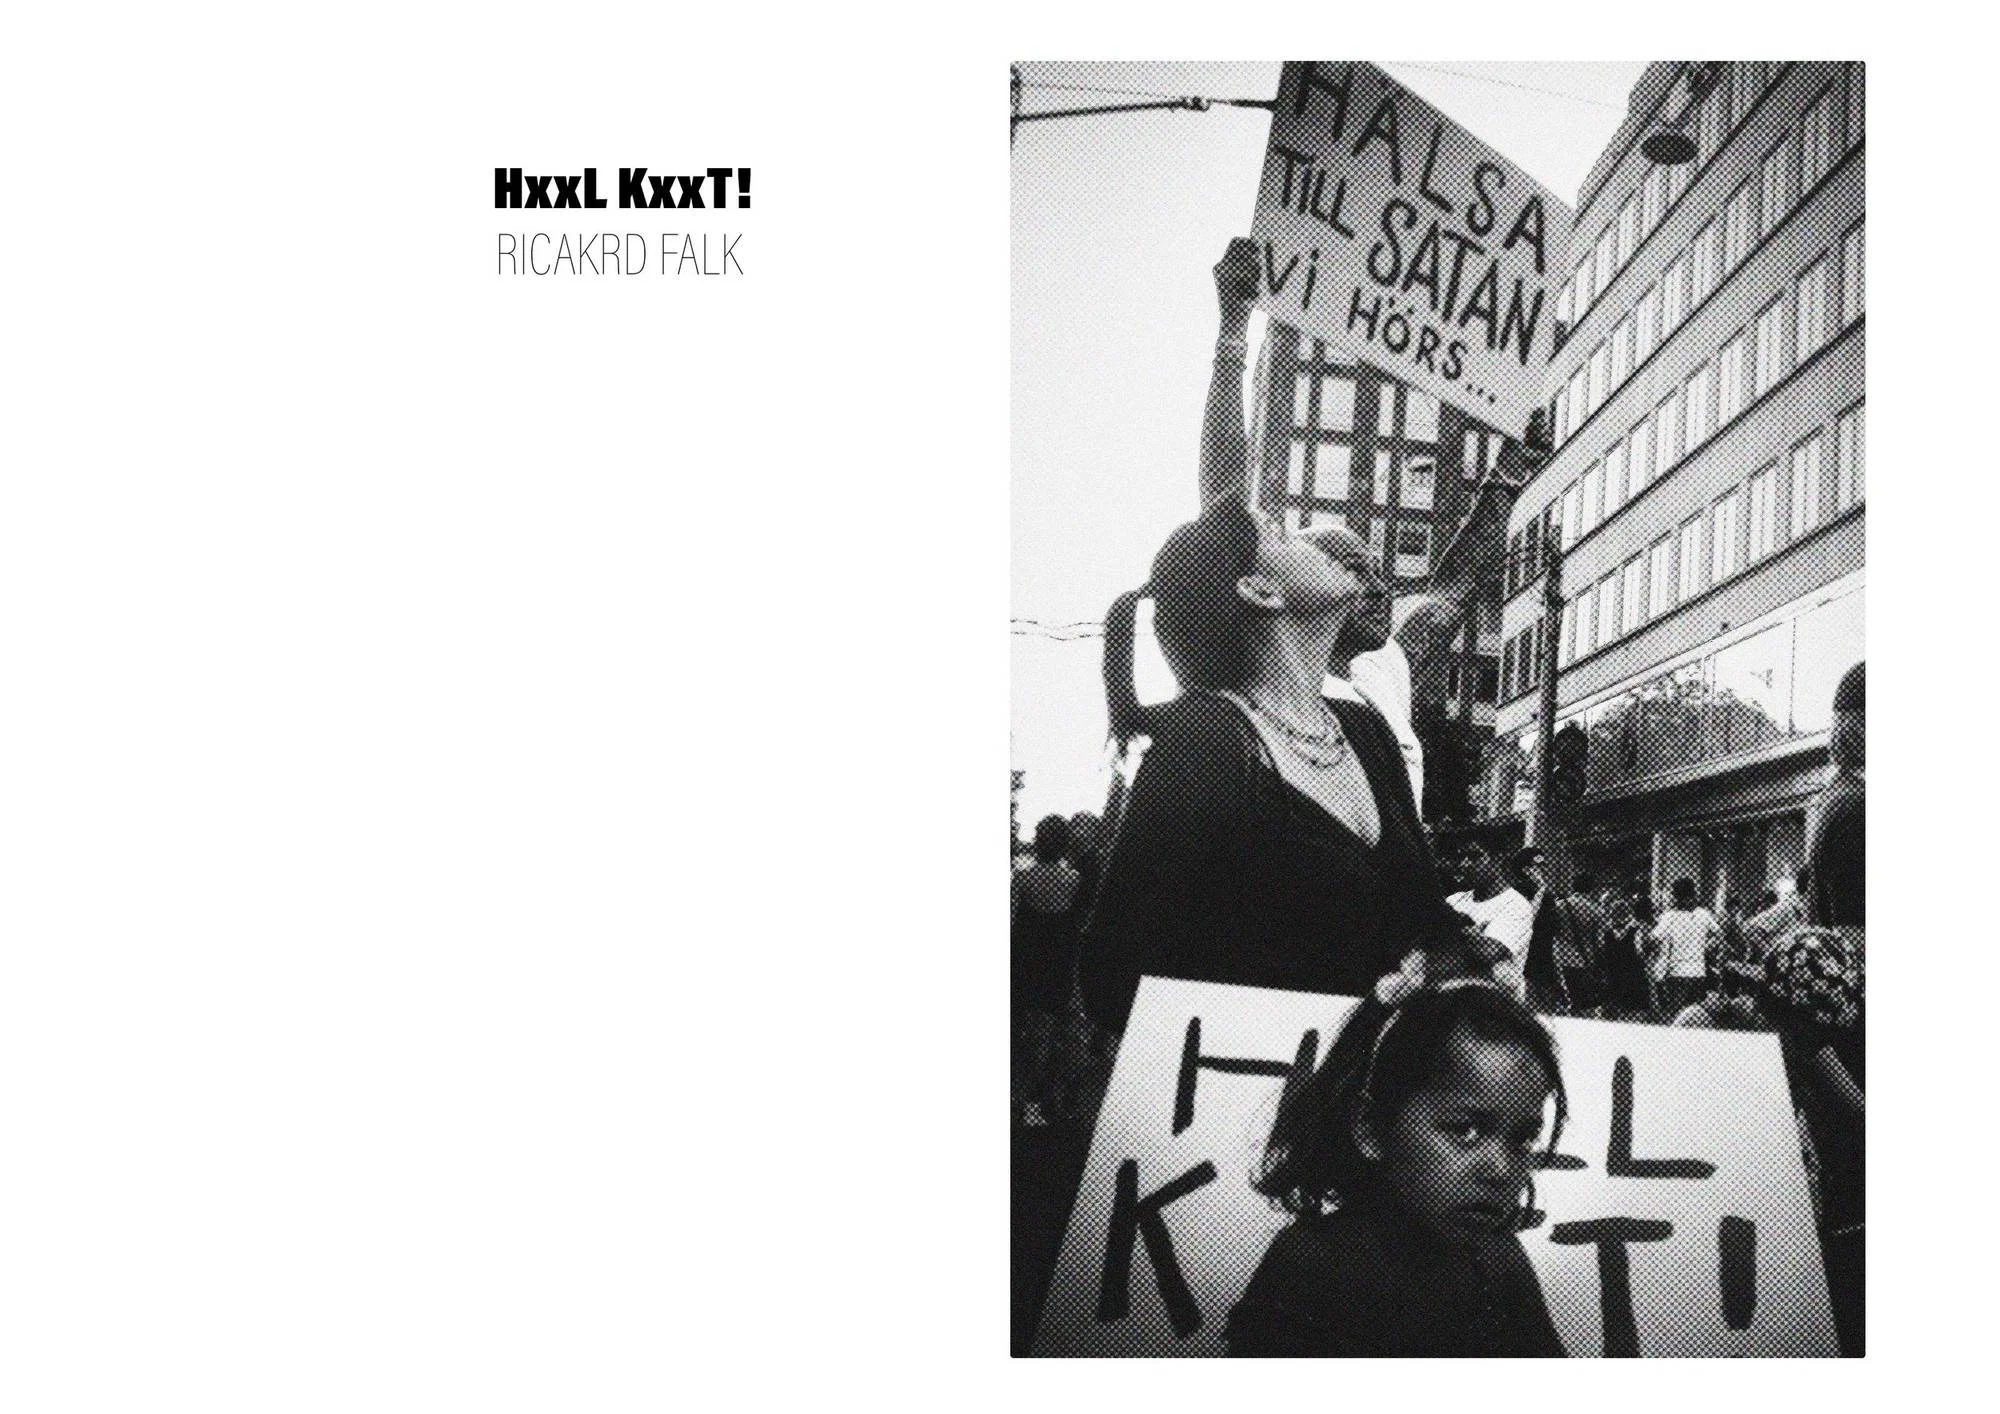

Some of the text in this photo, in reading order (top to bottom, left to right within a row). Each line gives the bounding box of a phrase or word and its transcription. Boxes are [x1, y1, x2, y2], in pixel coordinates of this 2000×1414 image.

[1272, 145, 1545, 365] TILL SATAN
[1172, 1016, 1717, 1179] HL
